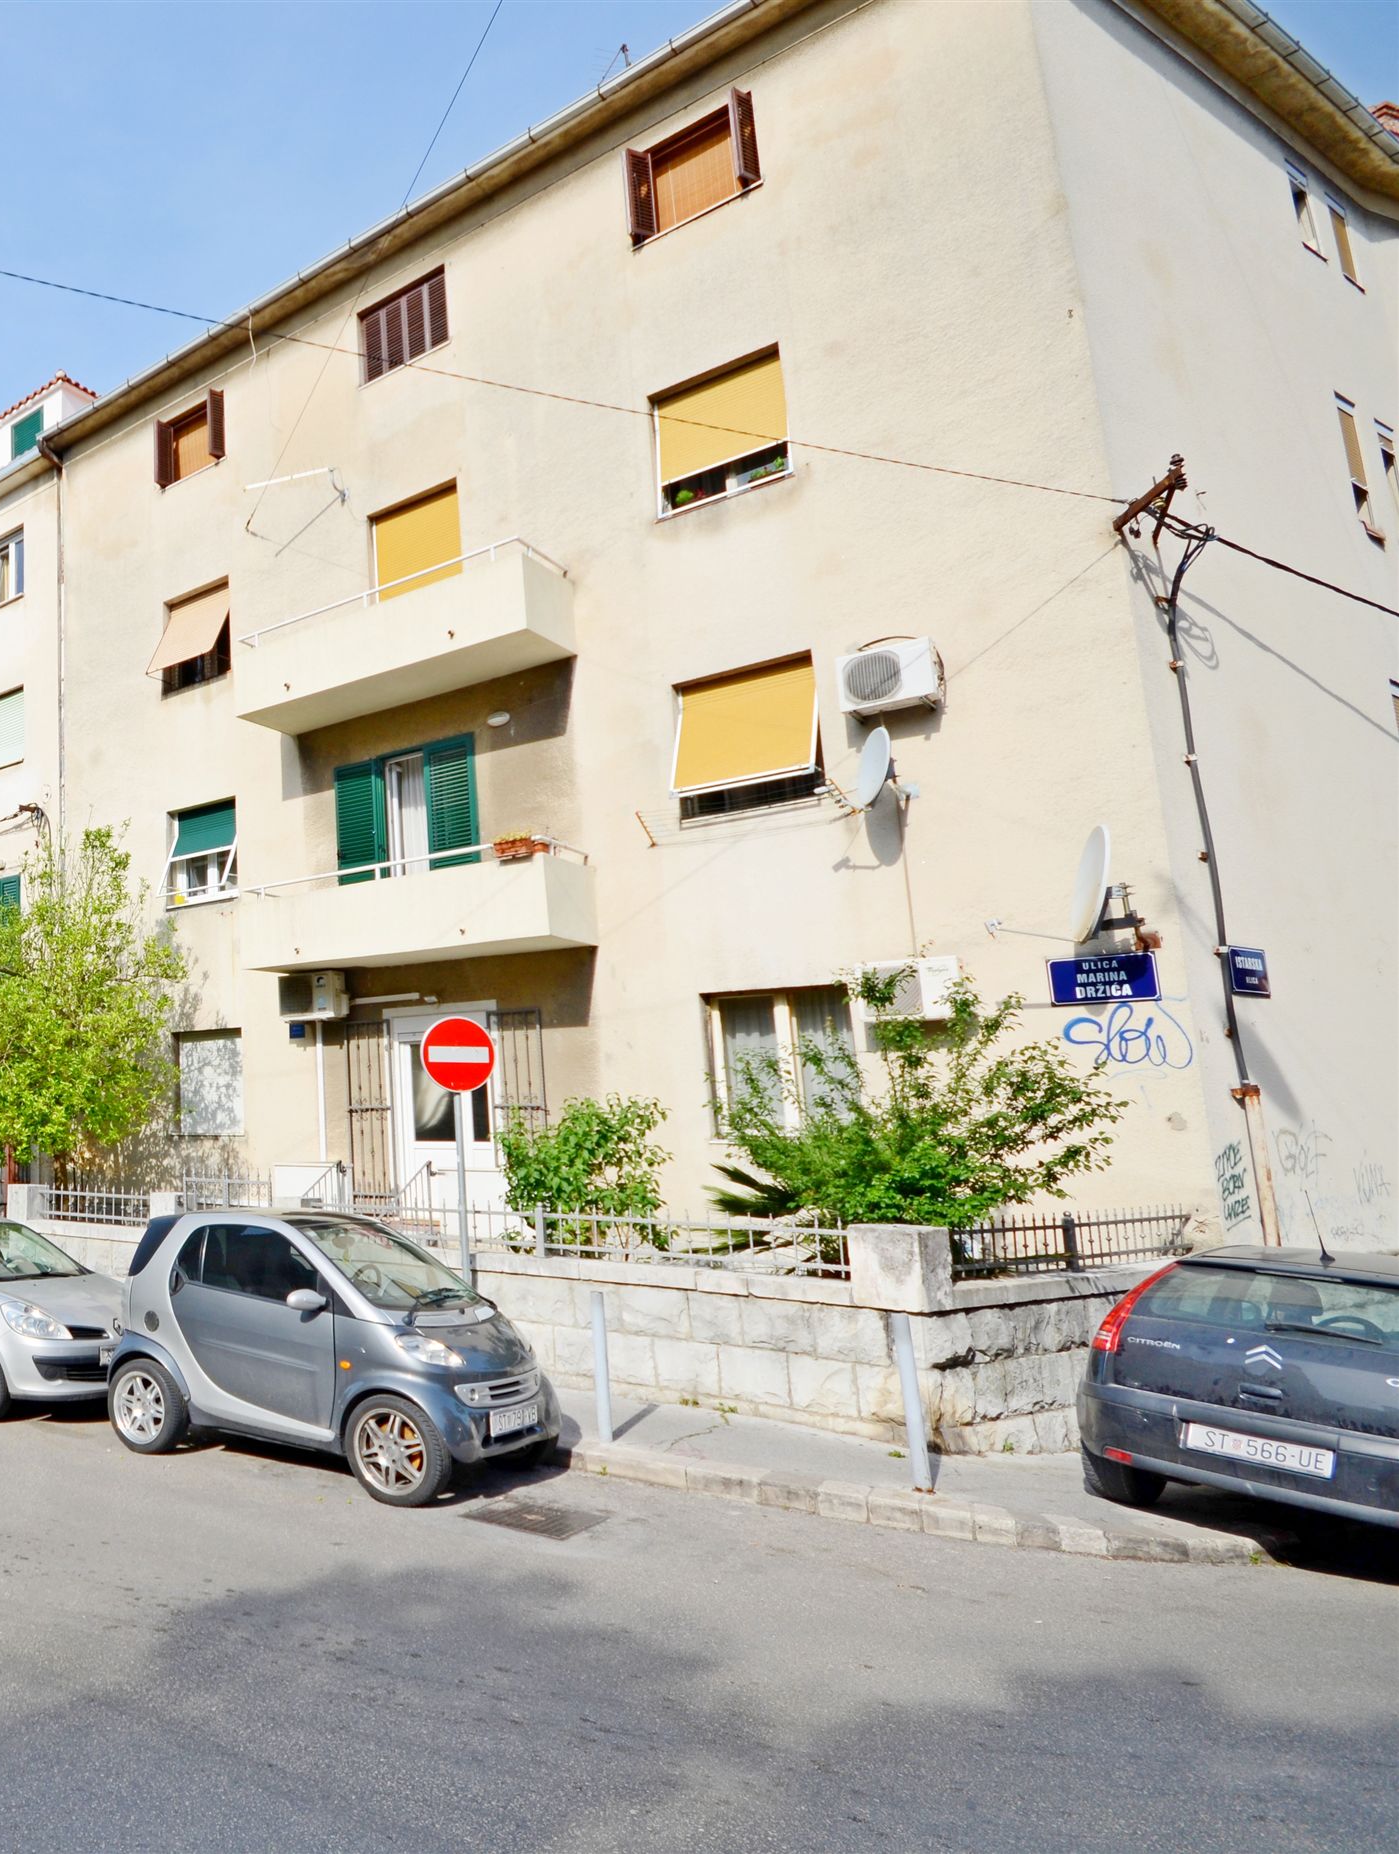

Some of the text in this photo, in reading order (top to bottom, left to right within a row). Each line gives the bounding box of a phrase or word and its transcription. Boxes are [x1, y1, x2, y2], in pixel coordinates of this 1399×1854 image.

[1081, 960, 1118, 970] ULICA
[1076, 970, 1128, 984] MARINA
[1075, 982, 1133, 999] DRŽIĆA
[1204, 1430, 1326, 1471] ST 566-UE
